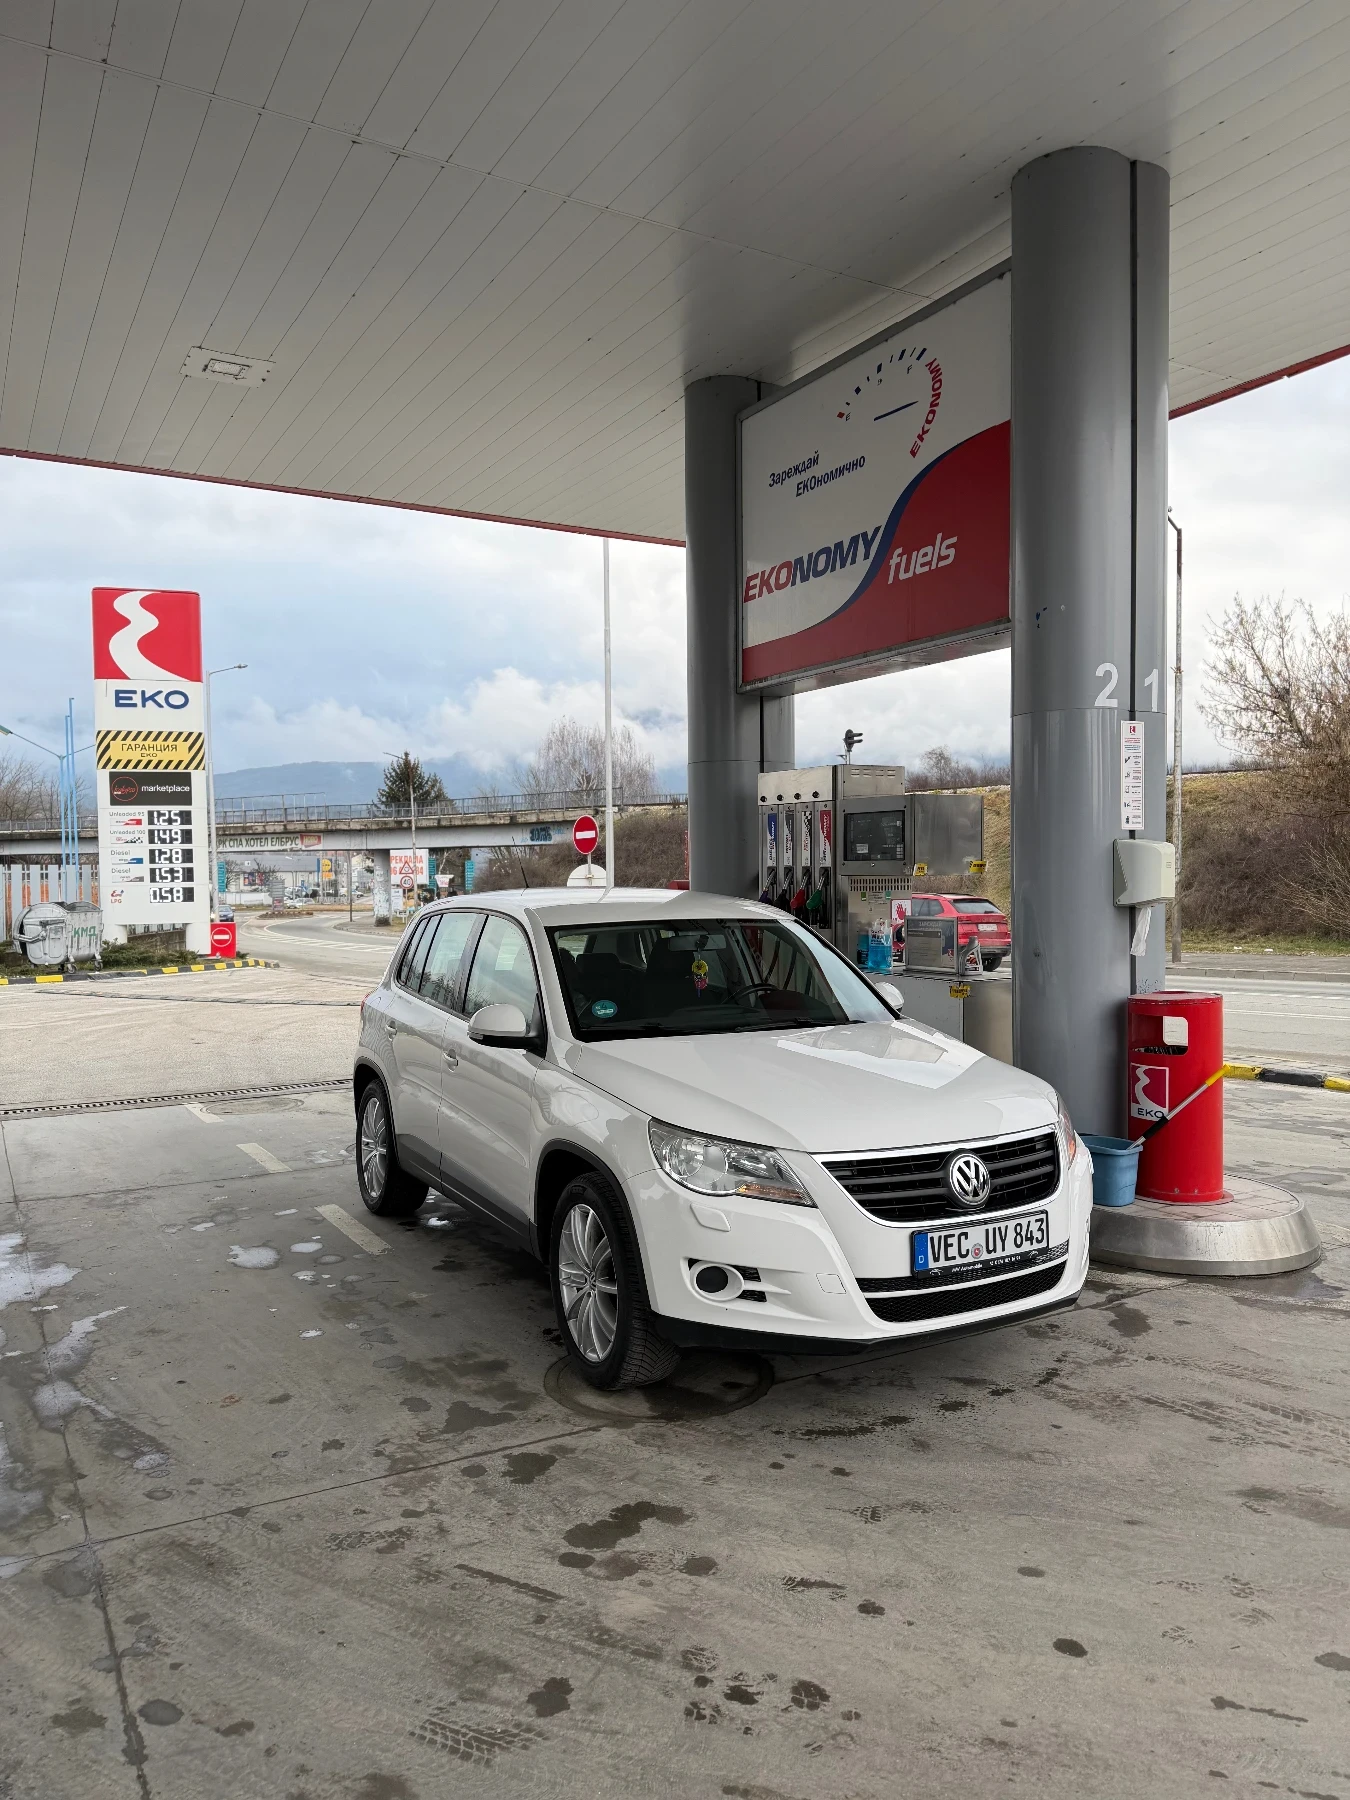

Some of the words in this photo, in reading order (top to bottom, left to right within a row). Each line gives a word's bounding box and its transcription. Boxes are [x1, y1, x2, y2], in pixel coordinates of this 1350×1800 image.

[909, 357, 943, 459] EKONOMY
[768, 450, 820, 488] Зареждай
[795, 455, 866, 498] ЕКОномично
[743, 524, 883, 604] EKONOMY
[887, 532, 958, 585] fuels
[1094, 662, 1119, 708] 2
[1144, 668, 1159, 713] 1
[114, 689, 190, 710] EKO
[121, 743, 178, 753] ГАРАНЦИЯ
[141, 784, 191, 795] marketplace
[153, 810, 181, 826] 1.25
[154, 829, 182, 845] 1.49
[228, 837, 243, 848] СПА
[244, 836, 269, 848] ХОТЕЛ
[270, 835, 300, 847] ЕЛБРУС
[154, 848, 182, 864] 1.28
[155, 867, 183, 883] 1.53
[403, 878, 411, 886] 40
[149, 887, 184, 903] 0.58
[73, 925, 97, 939] КМД
[1137, 1107, 1165, 1119] EKO
[929, 1231, 970, 1264] VEC
[984, 1224, 1009, 1255] UY
[1013, 1217, 1046, 1249] 843
[918, 1254, 925, 1264] D
